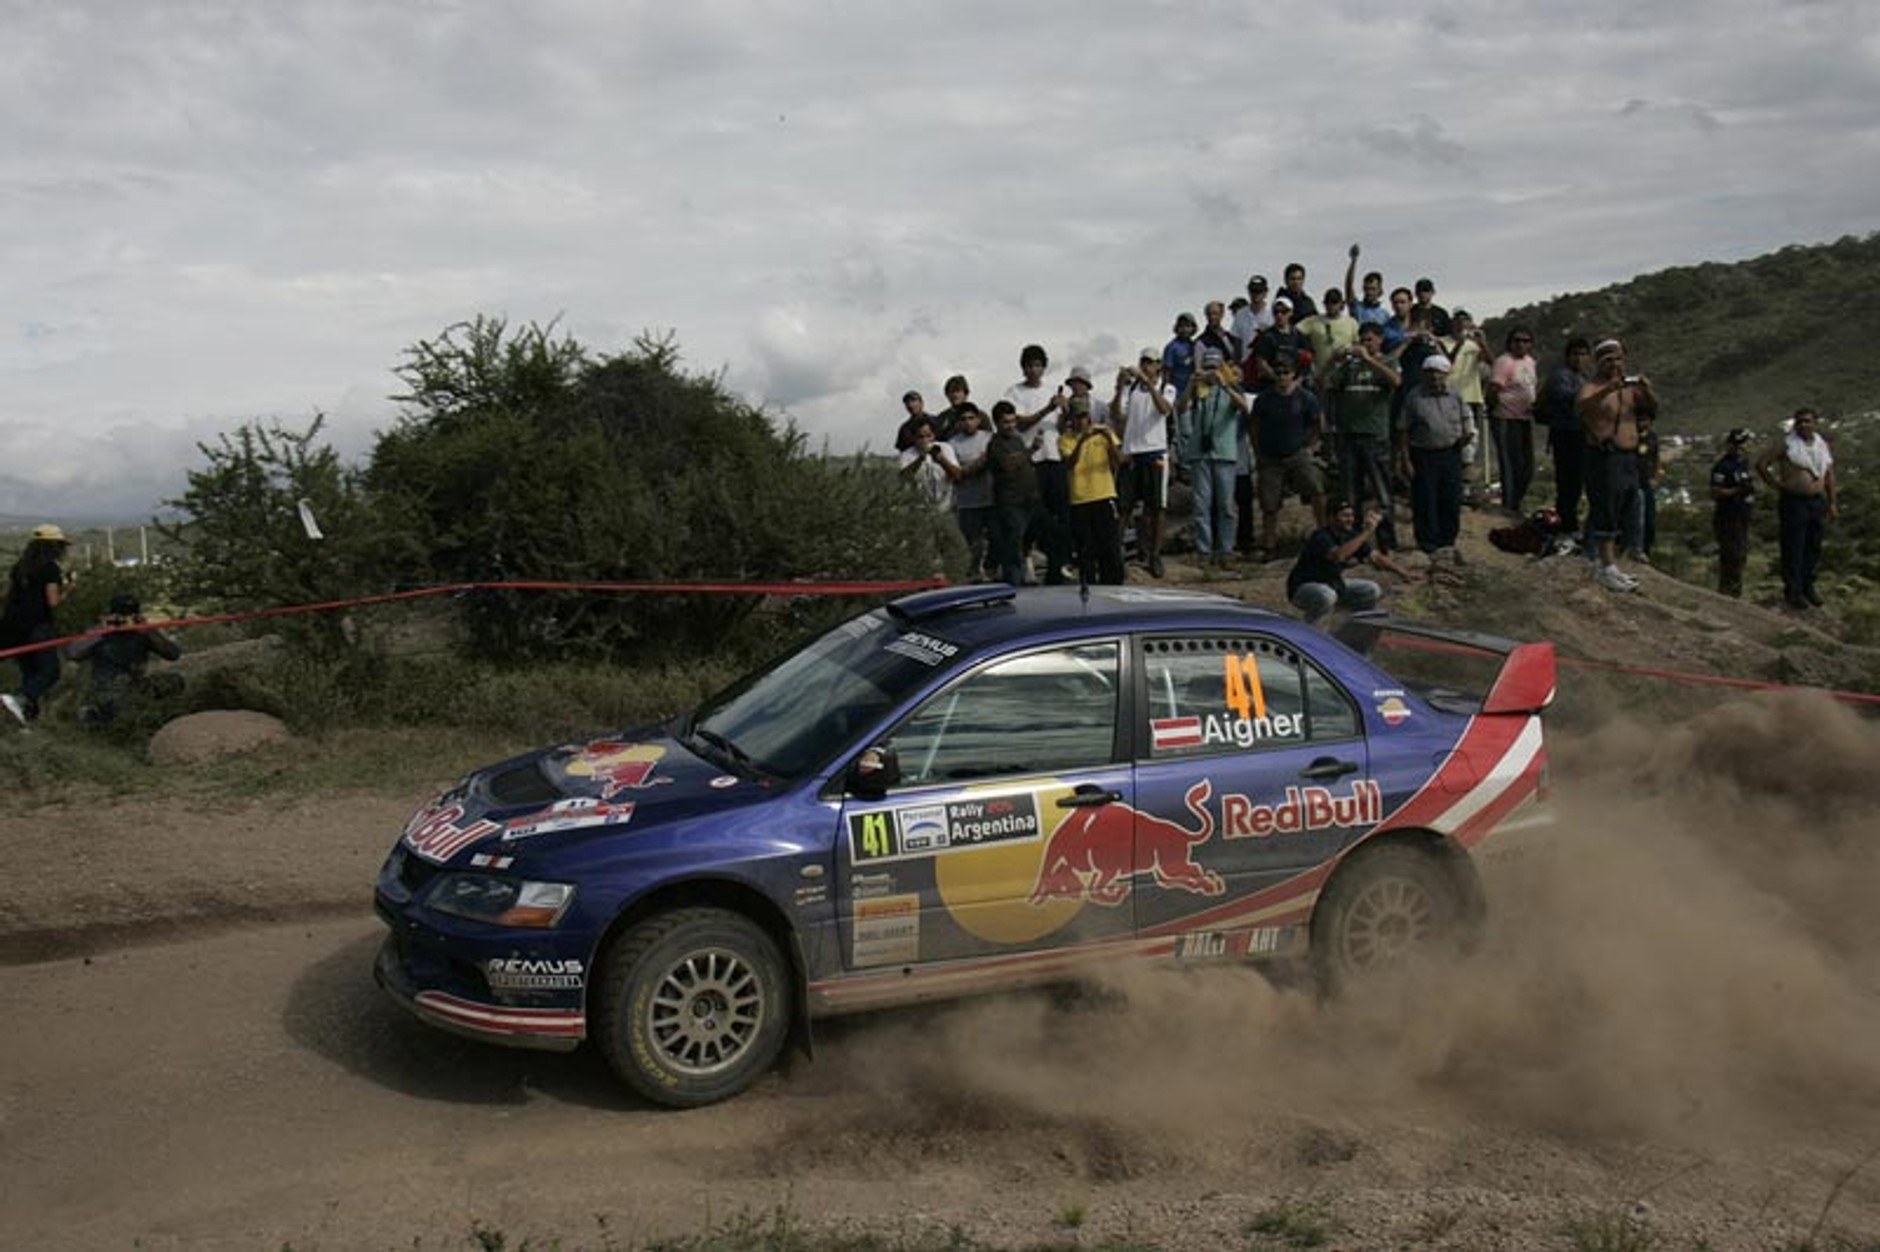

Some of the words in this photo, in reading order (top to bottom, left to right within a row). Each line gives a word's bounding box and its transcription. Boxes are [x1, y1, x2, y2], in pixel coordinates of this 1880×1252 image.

[1225, 652, 1266, 720] 41
[1203, 712, 1304, 747] Aigner
[950, 804, 984, 819] Rally
[1222, 786, 1301, 839] Red
[1302, 780, 1381, 830] Bull
[863, 812, 890, 857] 41
[951, 814, 1036, 841] Argentina
[488, 959, 583, 974] REMUS
